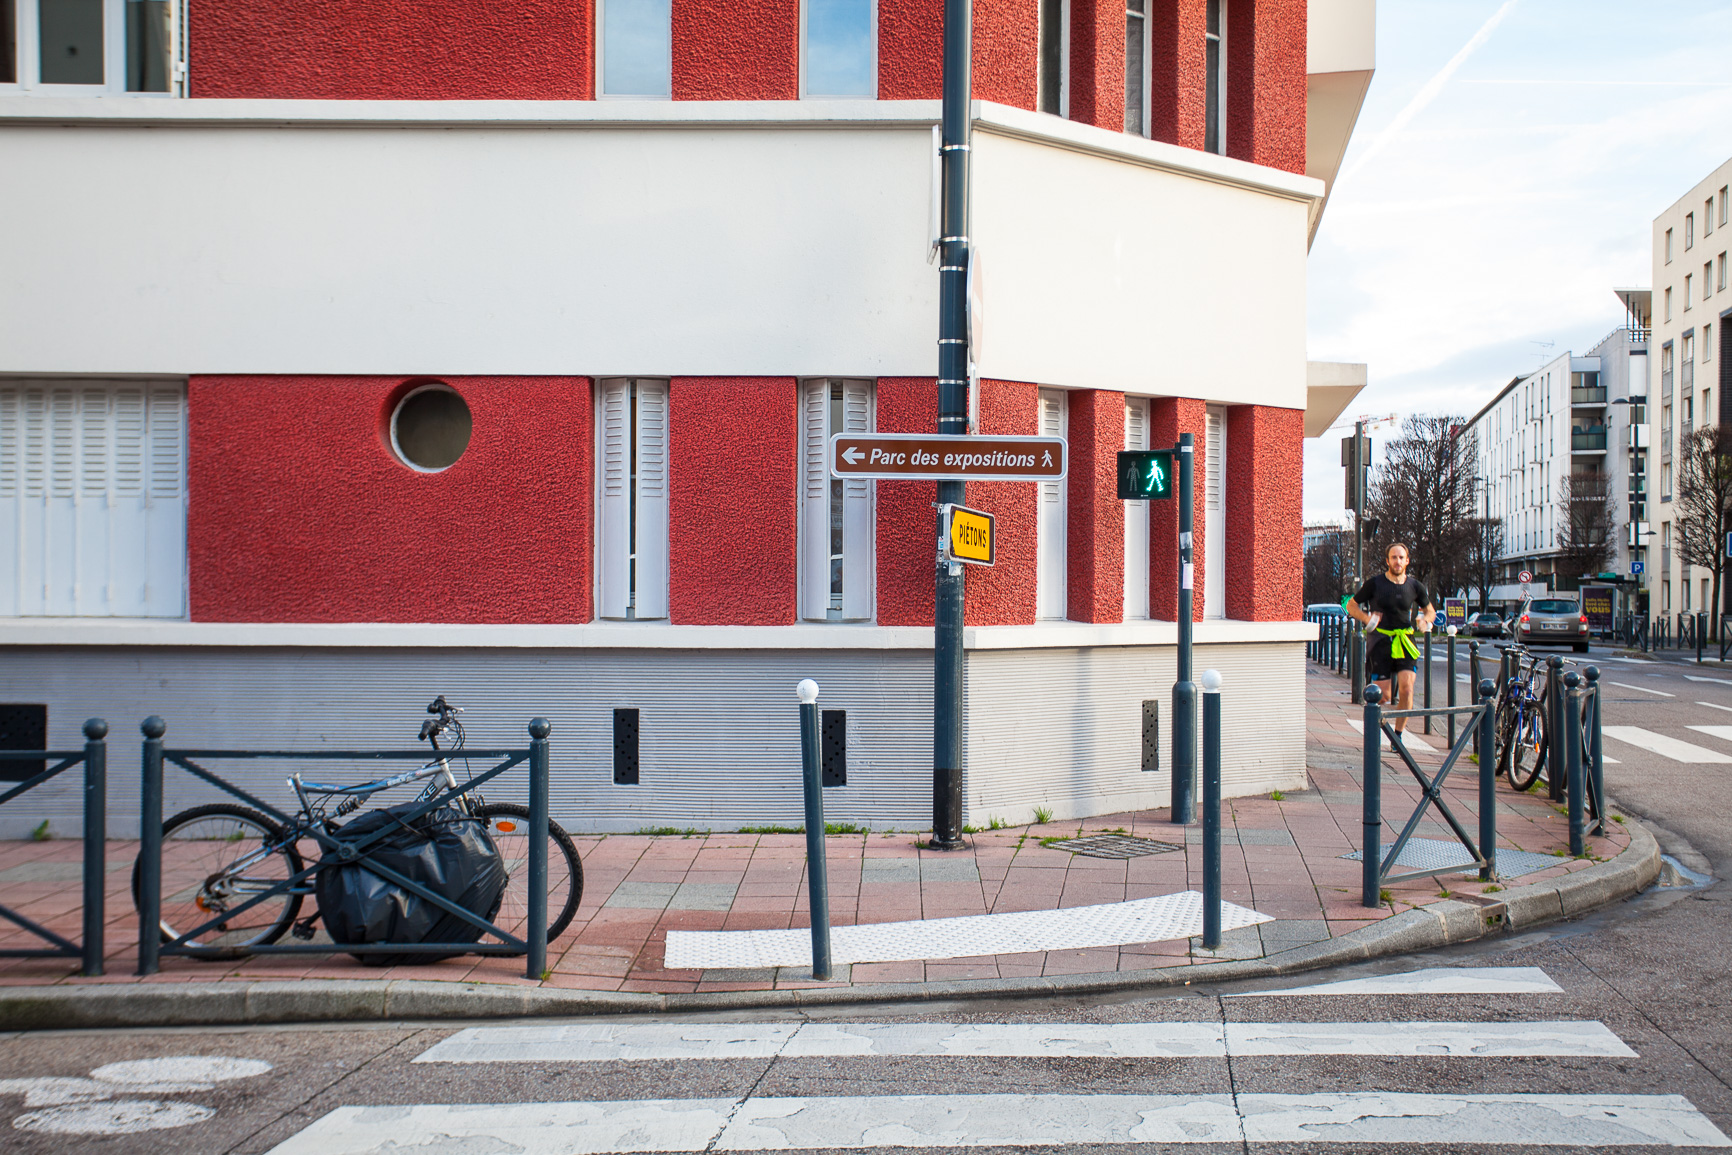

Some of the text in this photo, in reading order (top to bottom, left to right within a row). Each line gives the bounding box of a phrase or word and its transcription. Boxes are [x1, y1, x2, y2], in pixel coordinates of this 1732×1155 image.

[869, 448, 1035, 470] Parc des expositions
[959, 522, 987, 549] PIÉTONS
